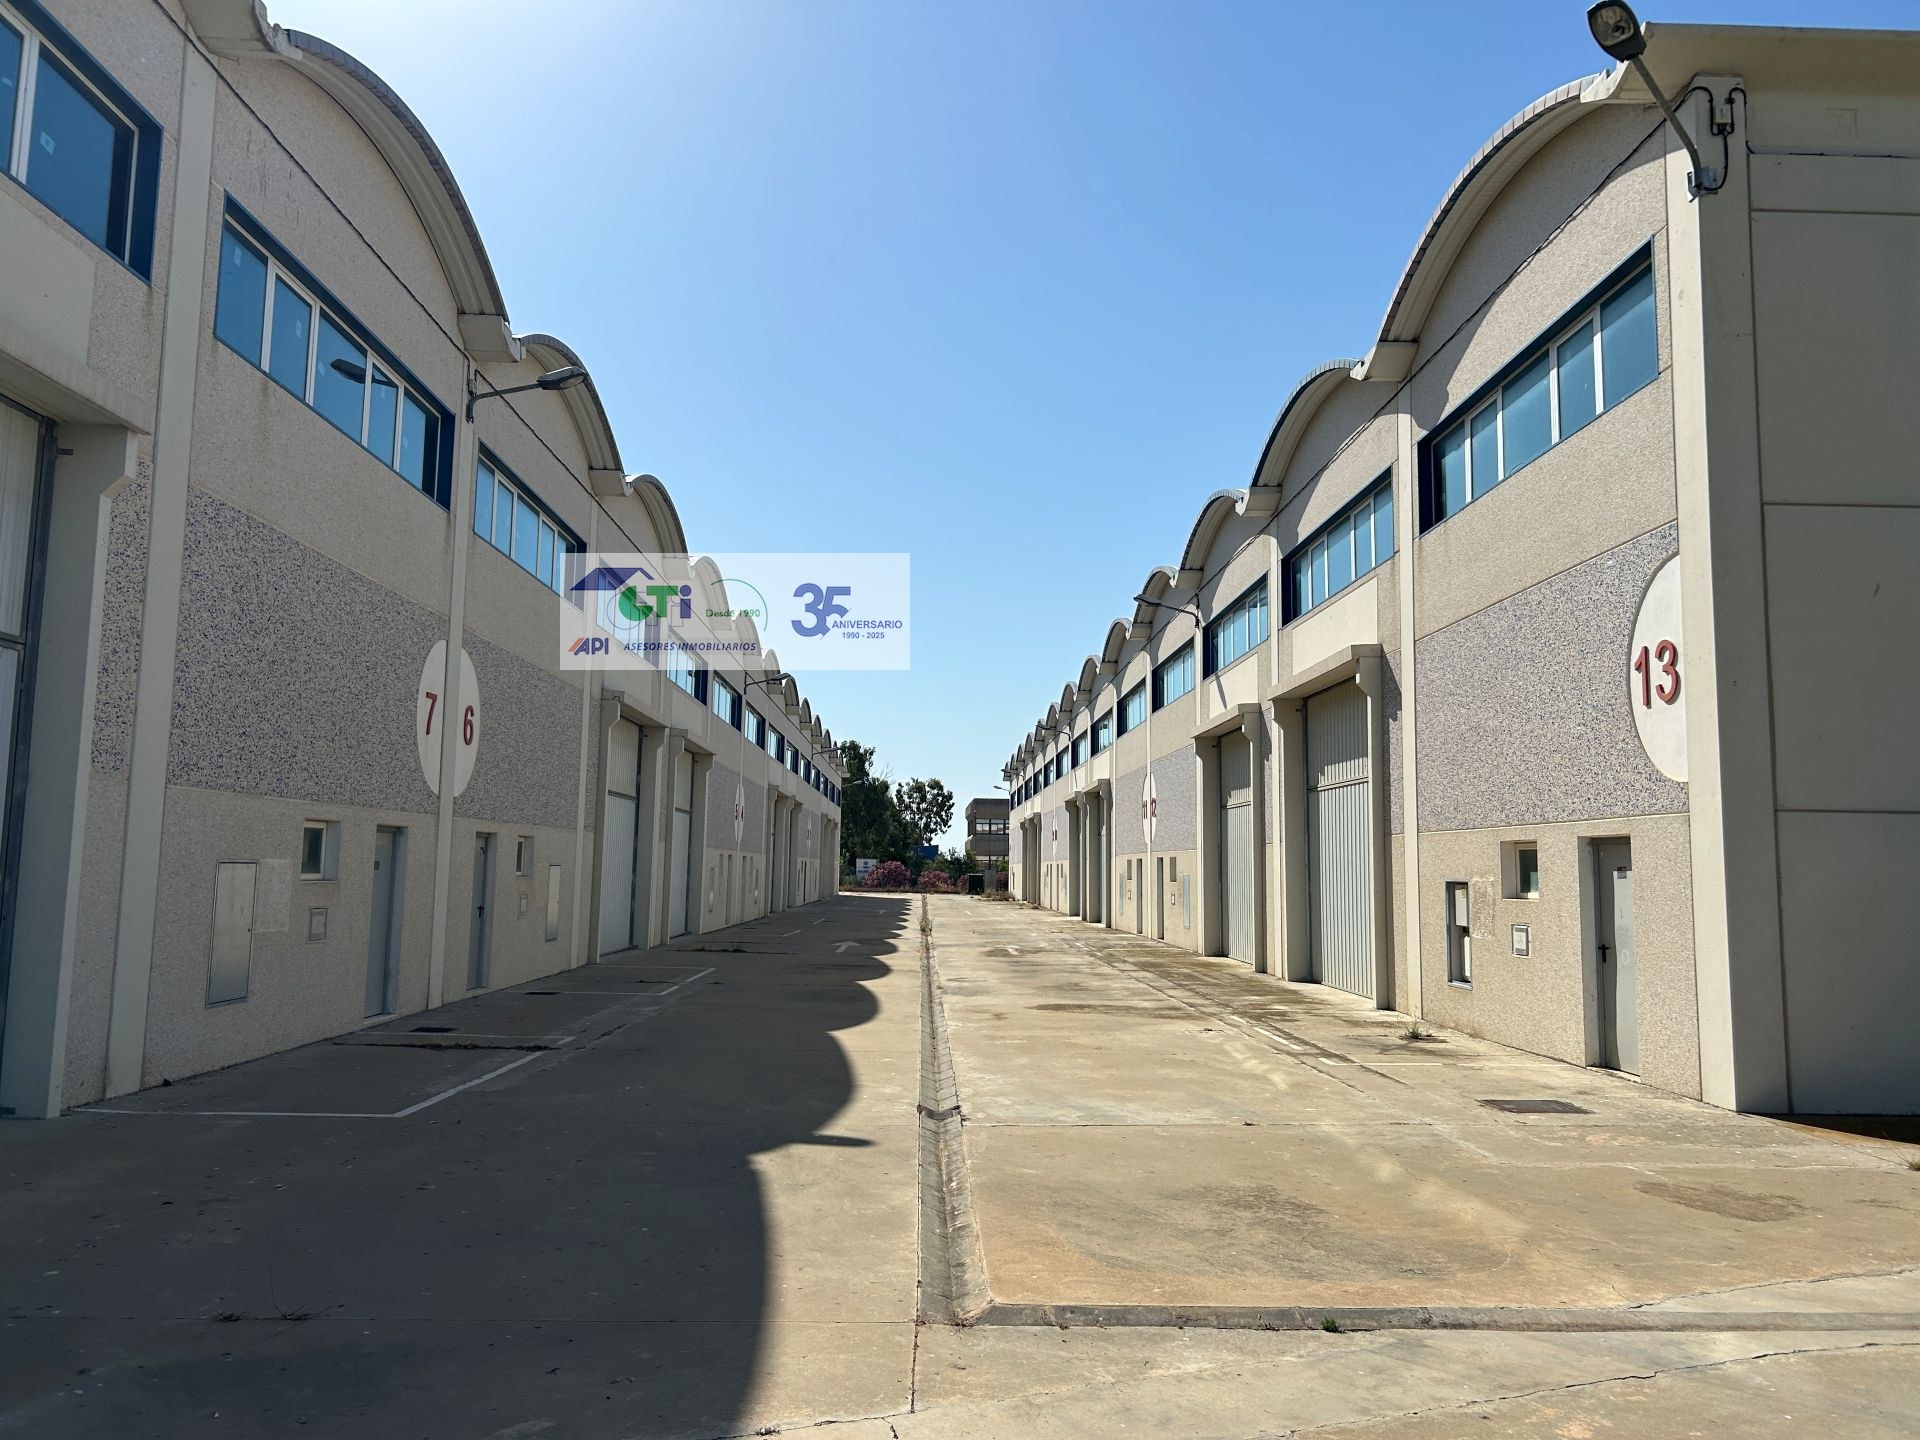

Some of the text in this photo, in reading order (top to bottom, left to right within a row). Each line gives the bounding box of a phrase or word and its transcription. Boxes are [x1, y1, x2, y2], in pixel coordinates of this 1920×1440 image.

[1633, 639, 1679, 707] 13
[425, 691, 438, 736] 7
[463, 704, 475, 746] 6
